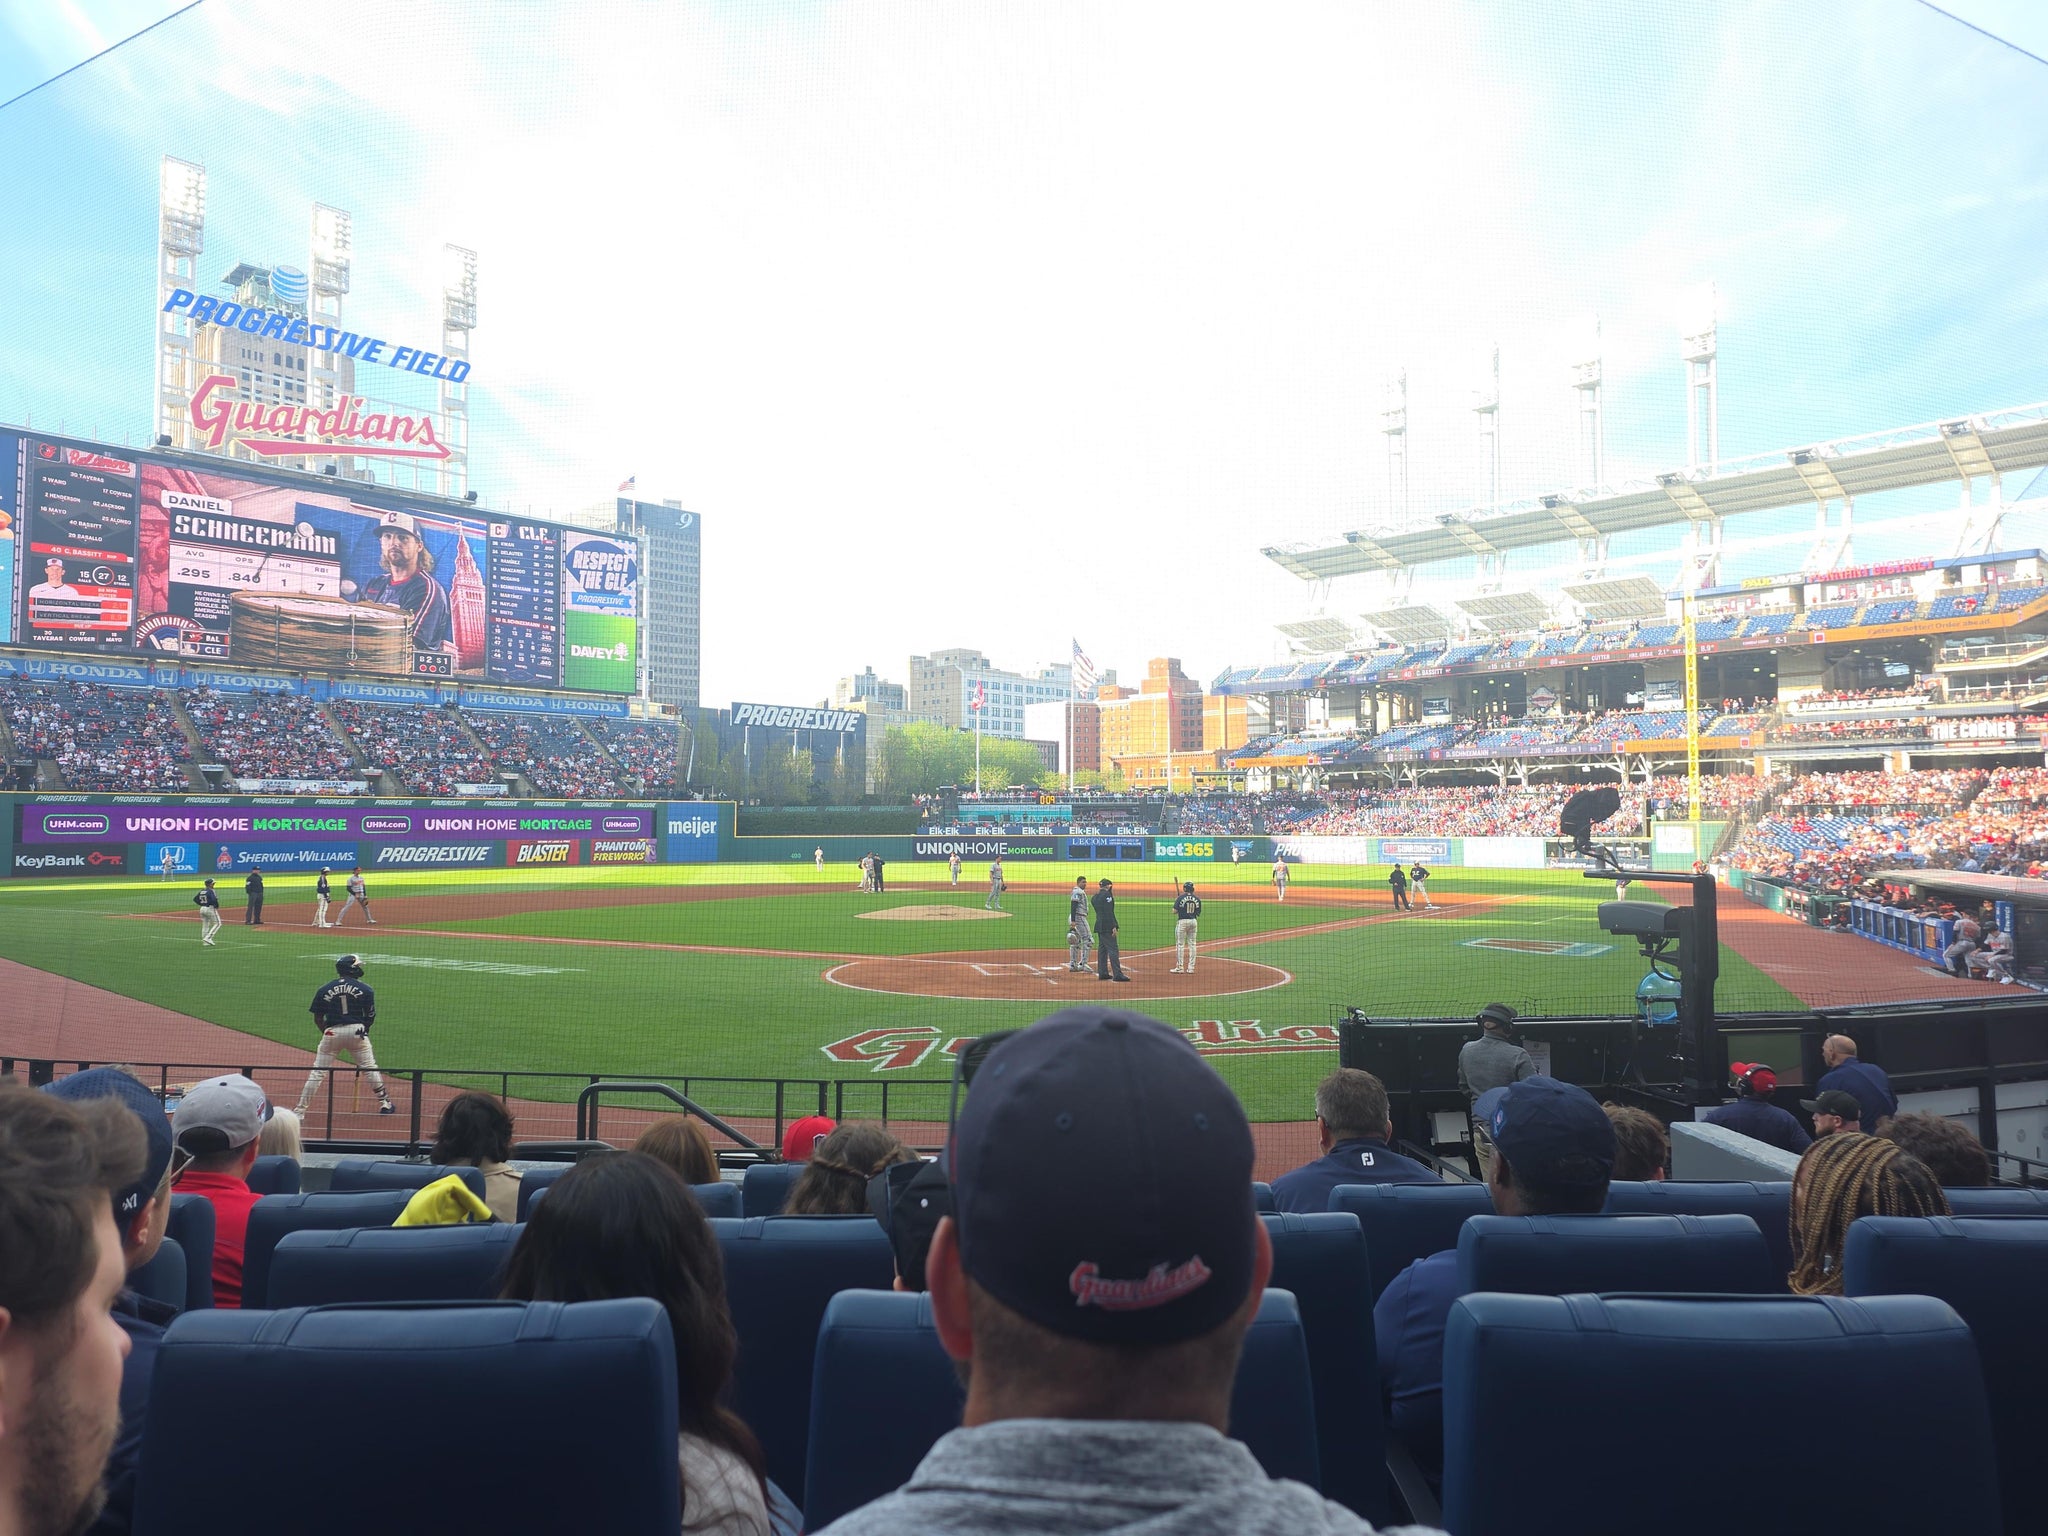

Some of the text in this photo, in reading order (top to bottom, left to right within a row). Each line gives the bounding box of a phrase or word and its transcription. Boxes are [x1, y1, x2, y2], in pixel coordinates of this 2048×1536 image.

[162, 288, 471, 383] PROGRESSIVE FIELD
[189, 374, 452, 459] Guardians
[79, 473, 105, 483] TAVERAS
[49, 493, 81, 503] HENDERSON
[109, 489, 133, 498] COWSER
[101, 502, 126, 511] JACKSON
[168, 494, 225, 513] DANIEL
[48, 507, 67, 515] MAYO
[78, 521, 103, 529] BASSITT
[110, 517, 132, 526] ALONSO
[174, 513, 336, 555] SCHNEEMANN
[519, 525, 548, 541] CLE
[72, 549, 103, 558] BASSITT
[185, 549, 205, 558] AVG
[235, 556, 254, 564] OPS
[572, 550, 629, 573] RESPECT
[177, 567, 211, 579] .295
[314, 566, 329, 574] RBI
[98, 572, 110, 580] 27
[117, 574, 127, 582] 12
[579, 569, 629, 591] THE CLE
[281, 578, 287, 587] 1
[316, 583, 325, 591] 7
[576, 593, 625, 606] PROGRESSIVE
[205, 634, 220, 643] BAL
[204, 646, 222, 655] CLE
[570, 644, 615, 660] DAVEY
[426, 656, 433, 664] 2
[443, 657, 448, 665] 1
[1591, 654, 1610, 662] CUTTER
[48, 663, 145, 680] HONDA
[1422, 668, 1443, 676] BASSITT
[212, 675, 295, 690] HONDA
[357, 685, 429, 699] HONDA
[481, 695, 545, 708] HONDA
[563, 701, 623, 713] HONDA
[733, 704, 861, 732] PROGRESSIVE
[1932, 721, 2017, 740] THE CORNER
[35, 794, 89, 803] PROGRESSIVE
[112, 795, 163, 804] PROGRESSIVE
[184, 796, 232, 804] PROGRESSIVE
[251, 797, 296, 805] PROGRESSIVE
[314, 798, 357, 806] PROGRESSIVE
[430, 799, 467, 807] PROGRESSIVE
[483, 800, 519, 808] PROGRESSIVE
[49, 817, 638, 832] UHM.com UNION HOME MORTGAGE UHM.com UNION HOME MORTGAGE UHM.com
[668, 816, 718, 838] meijer
[594, 841, 646, 851] PHANTOM
[1007, 847, 1054, 855] MORTGAGE
[1155, 842, 1214, 857] bet365
[376, 846, 490, 863] PROGRESSIVE
[516, 843, 570, 863] BLASTER
[593, 852, 646, 862] FIREWORKS
[15, 854, 86, 869] KeyBank
[149, 864, 194, 872] HODA
[1186, 902, 1196, 914] 10
[323, 983, 364, 1002] MARTÍNEZ
[339, 995, 349, 1015] 1
[1069, 1254, 1213, 1310] Guardians
